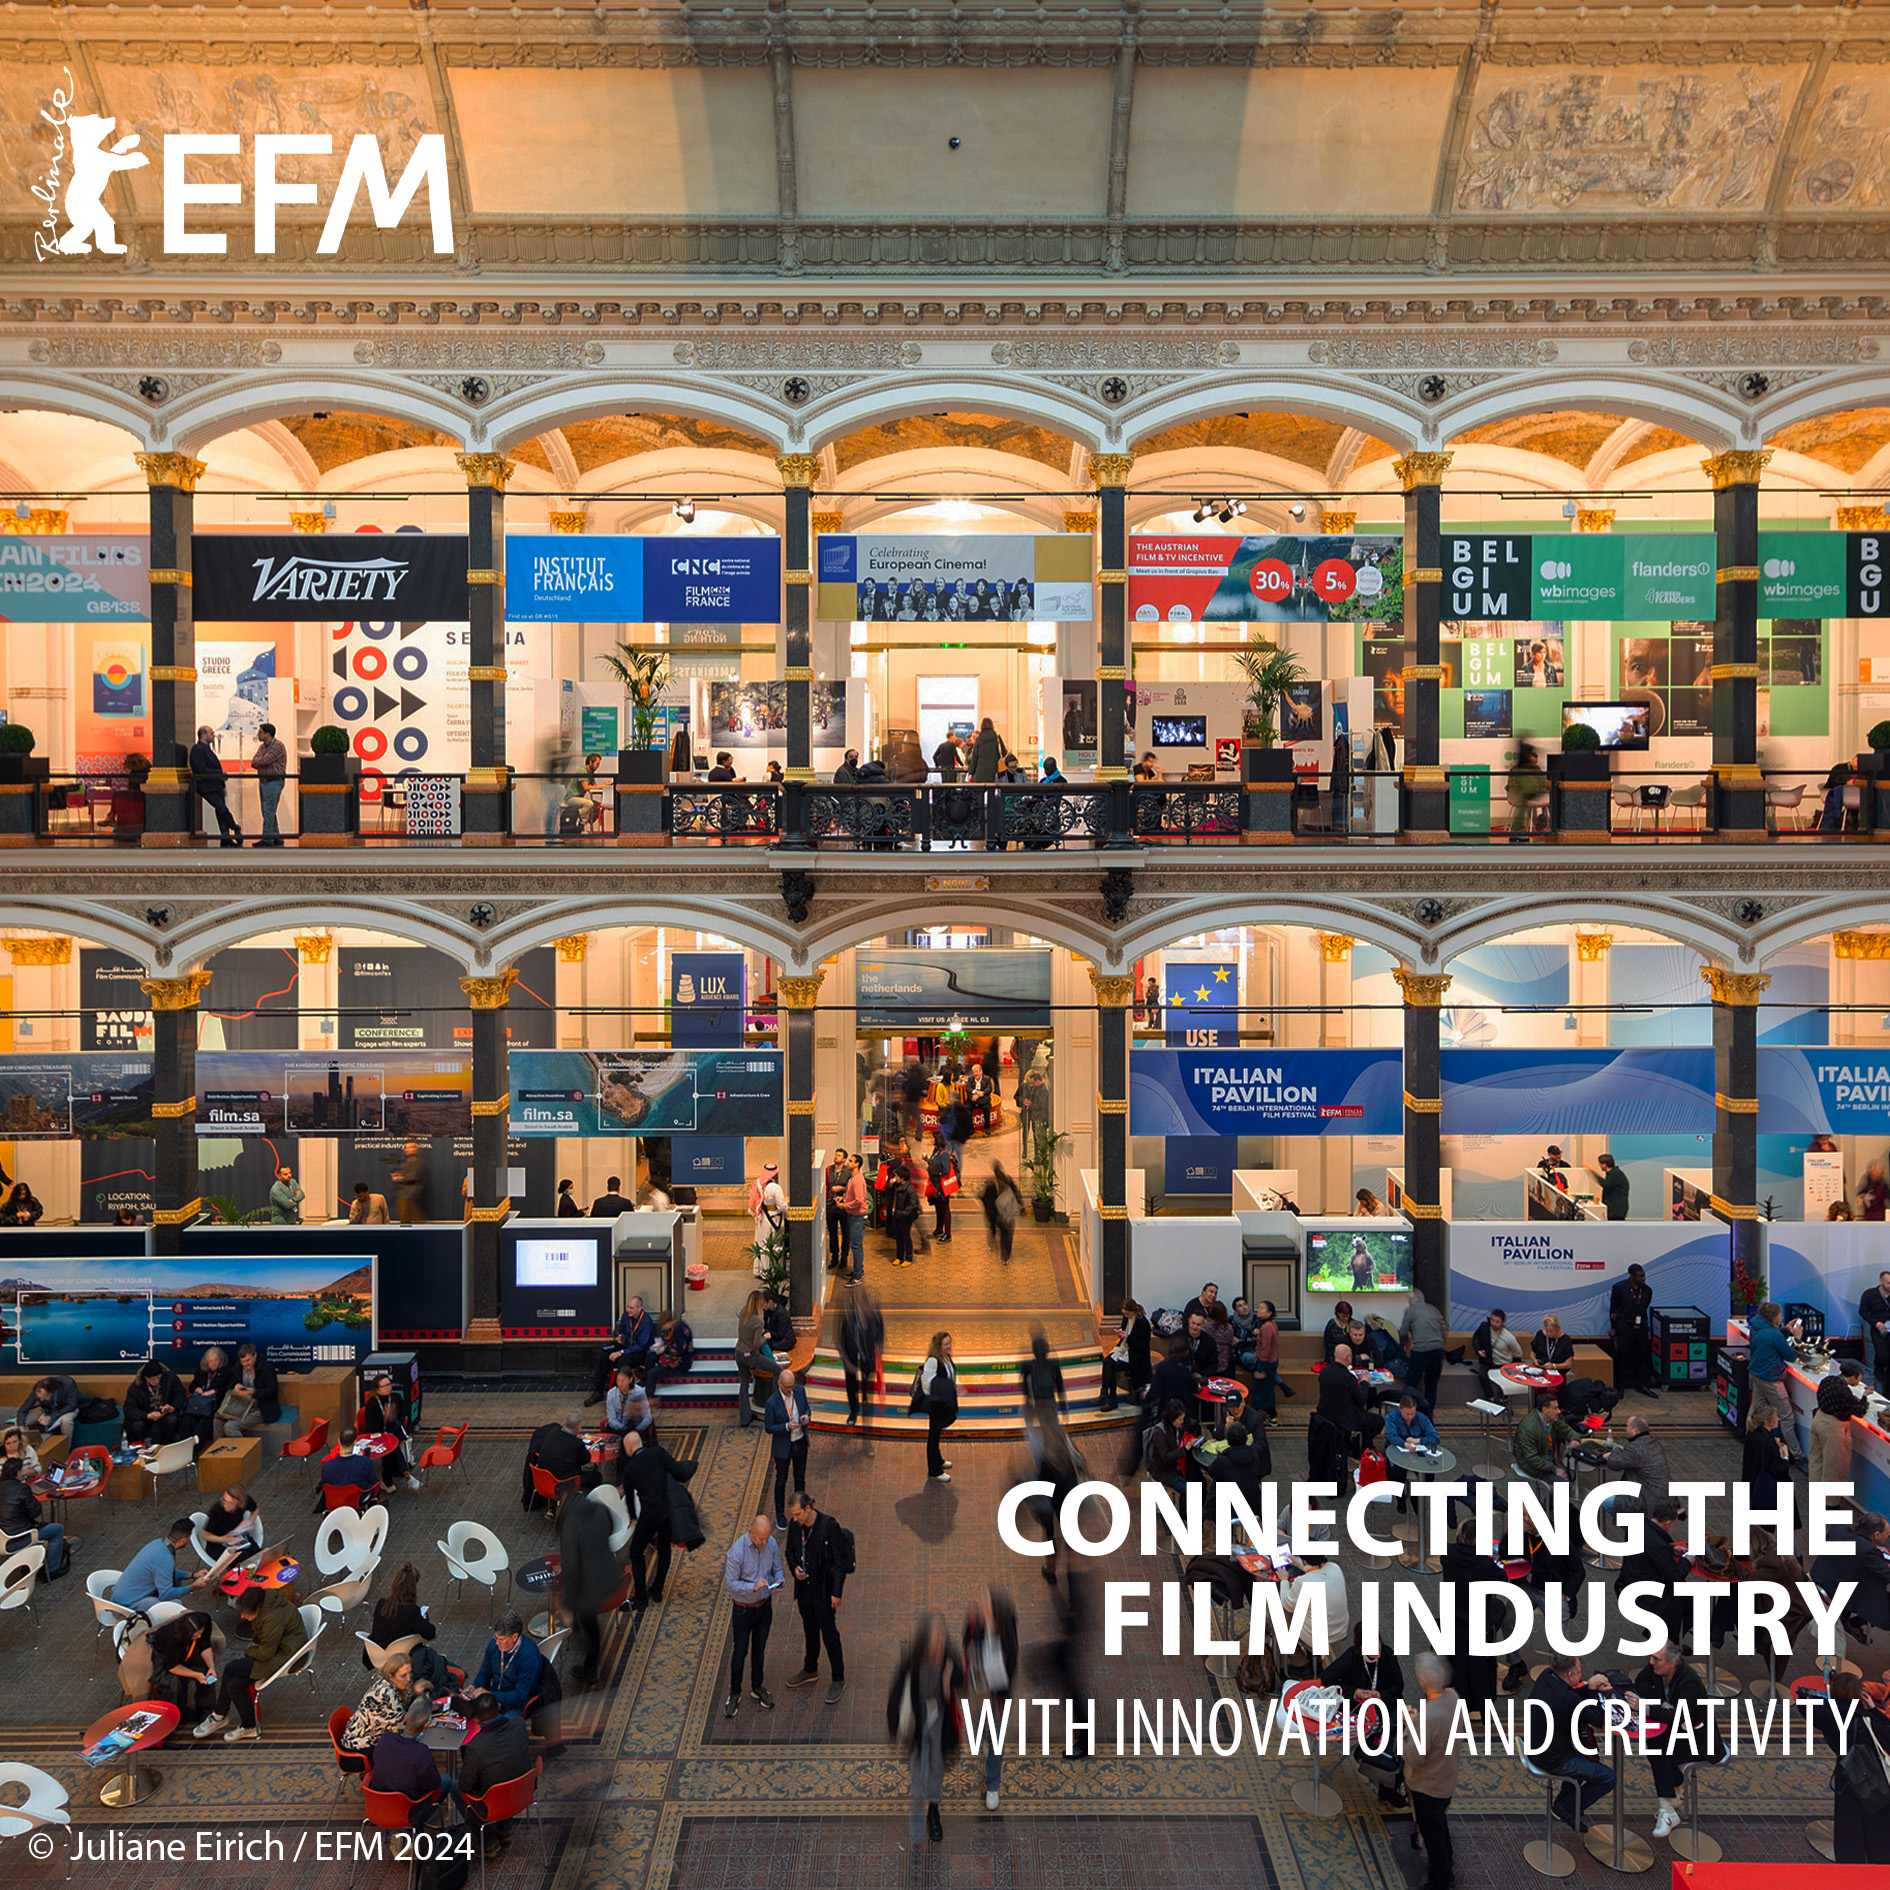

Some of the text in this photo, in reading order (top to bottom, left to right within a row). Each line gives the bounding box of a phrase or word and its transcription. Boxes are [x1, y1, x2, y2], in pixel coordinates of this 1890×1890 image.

[870, 547, 930, 560] Celebrating
[534, 557, 606, 576] INSTITUT
[672, 558, 720, 575] CNC
[870, 559, 987, 572] European Cinema!
[1632, 562, 1697, 577] flanders
[252, 556, 409, 601] VARIETY
[534, 573, 614, 595] FRANÇAIS
[1256, 571, 1290, 590] 30%
[1326, 572, 1347, 590] 5%
[686, 586, 711, 596] FILM
[1540, 585, 1616, 601] wbimages
[1764, 583, 1840, 599] wbimages
[87, 601, 141, 614] GB138
[686, 597, 731, 607] FRANCE
[446, 632, 526, 645] SEIA
[202, 657, 231, 665] STUDIO
[202, 666, 231, 674] GREECE
[1655, 760, 1688, 769] flanders
[862, 974, 879, 983] the
[701, 977, 726, 994] LUX
[861, 983, 923, 993] netherlands
[96, 1011, 153, 1023] SAUDI
[359, 1029, 420, 1037] CONFERENCE:
[1186, 1030, 1219, 1047] USE
[1194, 1068, 1282, 1084] ITALIAN
[1212, 1087, 1317, 1103] PAVILION
[209, 1109, 260, 1122] film.sa
[523, 1108, 574, 1121] film.sa
[1491, 1236, 1550, 1247] ITALIAN
[1503, 1249, 1574, 1260] PAVILION
